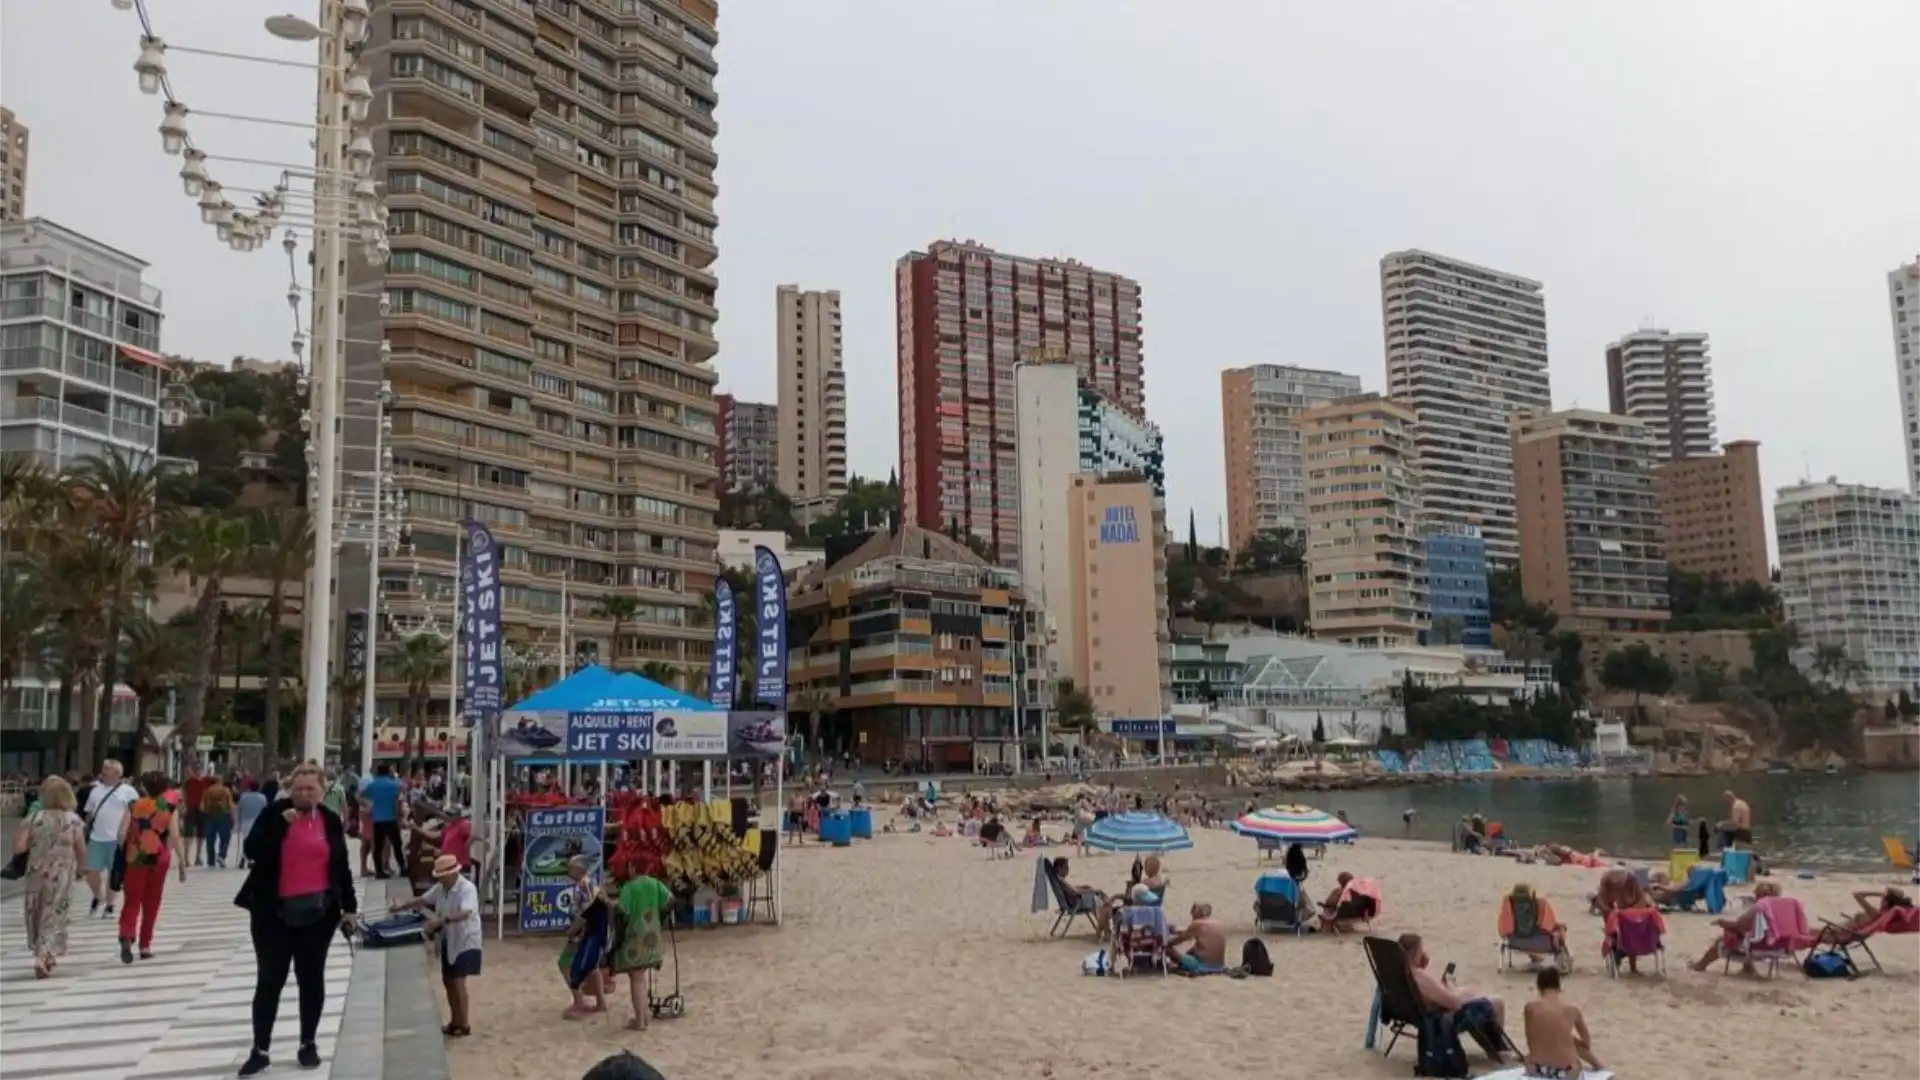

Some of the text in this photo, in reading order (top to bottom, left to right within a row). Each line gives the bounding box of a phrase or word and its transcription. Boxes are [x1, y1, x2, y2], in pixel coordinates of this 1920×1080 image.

[1100, 523, 1140, 543] NADAL
[476, 551, 495, 611] SKI
[479, 618, 497, 684] JET
[571, 714, 620, 729] ALQUILER
[571, 733, 611, 751] JET
[617, 733, 651, 751] SKI
[531, 810, 597, 825] Carlos
